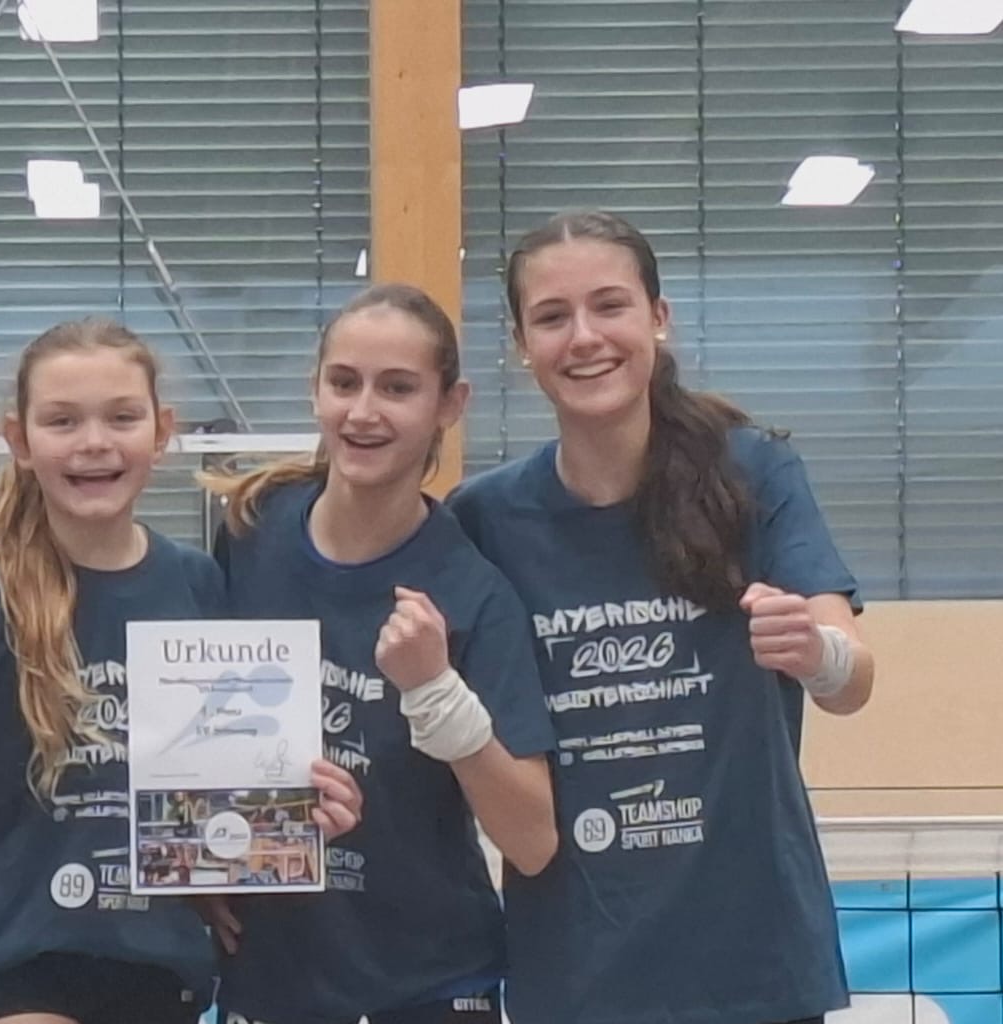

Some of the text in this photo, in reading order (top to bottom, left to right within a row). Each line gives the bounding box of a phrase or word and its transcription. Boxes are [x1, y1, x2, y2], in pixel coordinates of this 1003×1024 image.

[162, 637, 291, 664] Urkunde
[570, 632, 675, 677] 2026
[617, 797, 703, 826] TEAMSHOP
[583, 817, 606, 843] 89
[59, 873, 85, 899] 89
